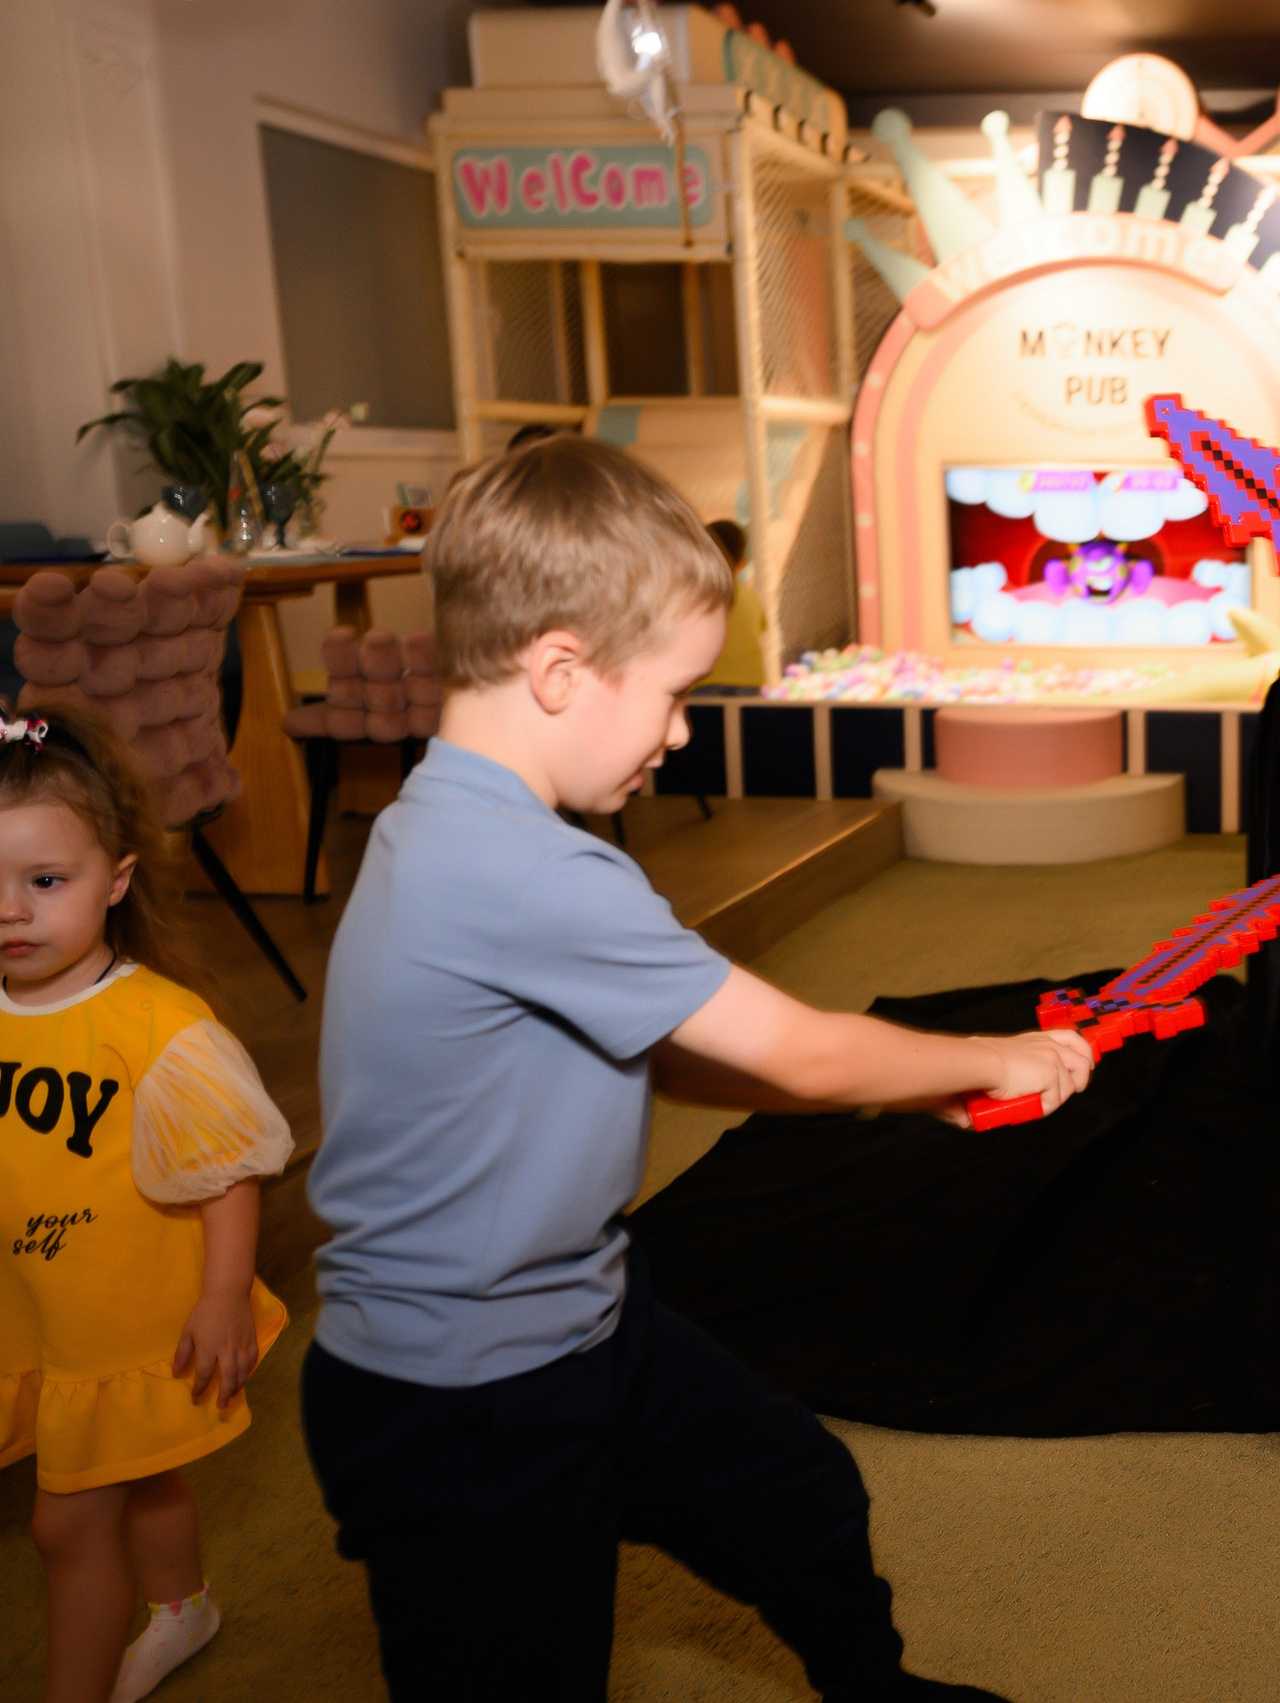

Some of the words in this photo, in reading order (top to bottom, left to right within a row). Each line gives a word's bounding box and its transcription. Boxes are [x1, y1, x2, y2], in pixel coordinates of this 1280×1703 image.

[1065, 375, 1129, 405] PUB
[26, 1208, 98, 1236] your
[12, 1228, 67, 1261] self
